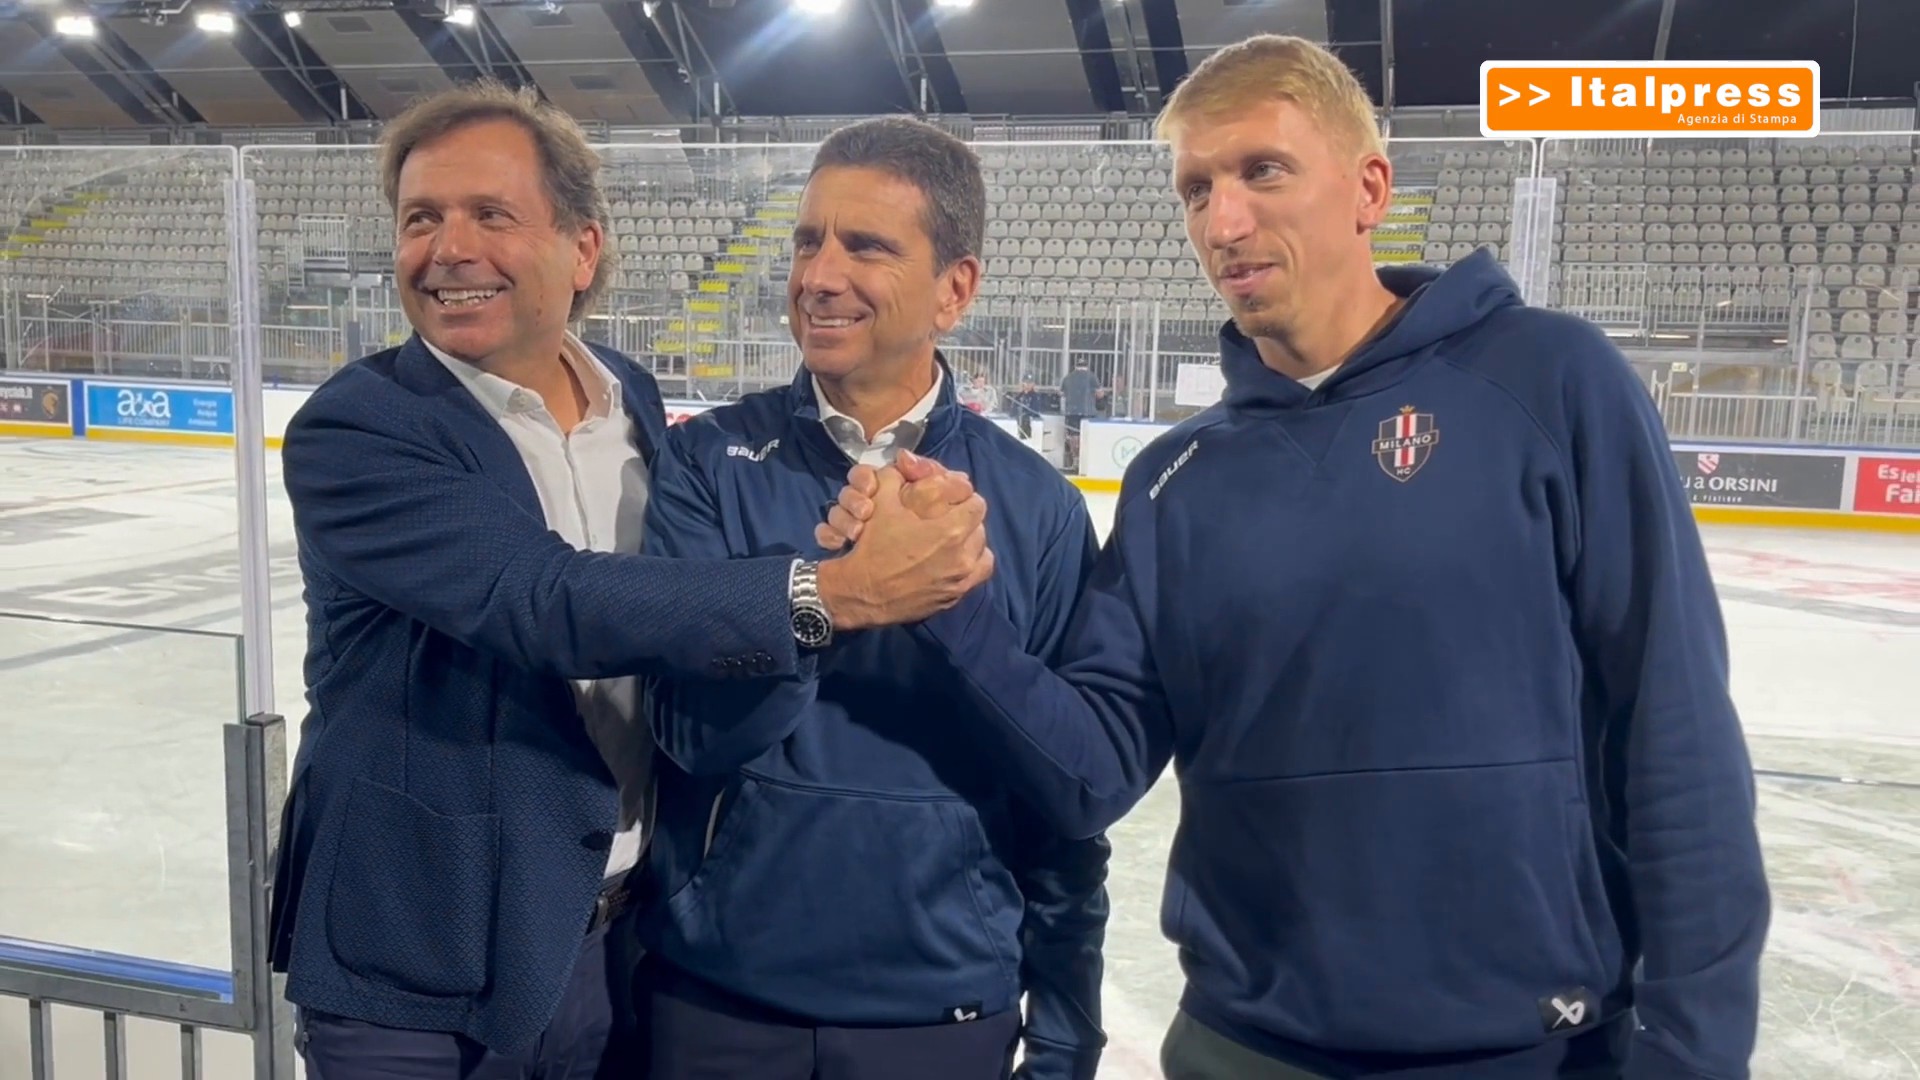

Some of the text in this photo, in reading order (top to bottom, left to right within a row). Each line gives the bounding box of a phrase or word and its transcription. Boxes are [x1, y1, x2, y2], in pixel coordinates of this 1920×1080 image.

[726, 438, 780, 462] BAUER
[1379, 434, 1431, 450] MILANO
[1149, 440, 1199, 500] BAUER
[1397, 466, 1411, 476] HC
[1708, 476, 1778, 493] ORSINI
